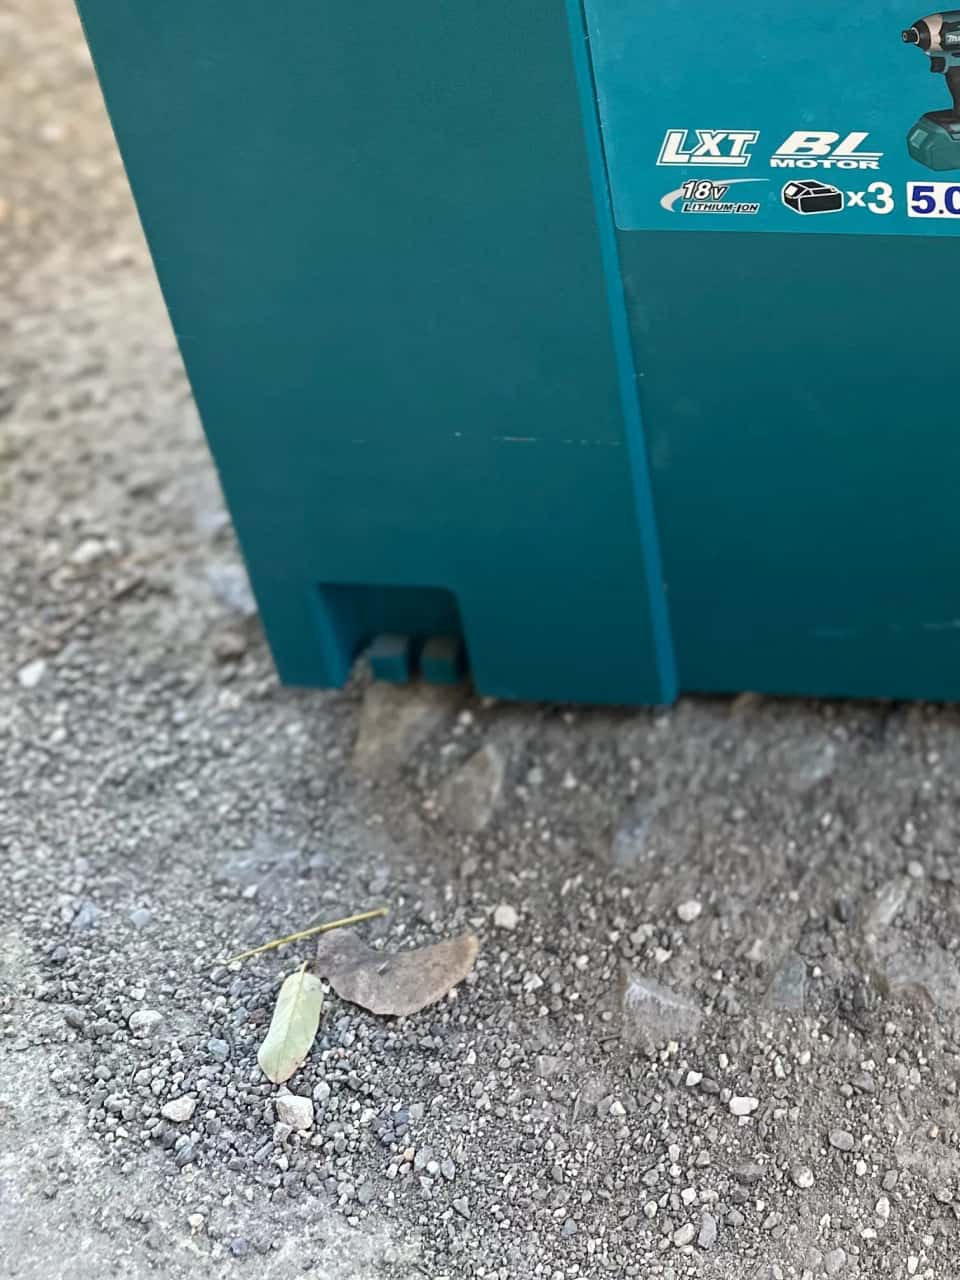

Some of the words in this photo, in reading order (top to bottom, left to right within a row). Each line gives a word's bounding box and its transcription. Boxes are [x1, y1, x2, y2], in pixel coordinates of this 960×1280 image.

[656, 129, 760, 167] LXT
[772, 130, 884, 158] BL
[770, 158, 880, 170] MOTOR
